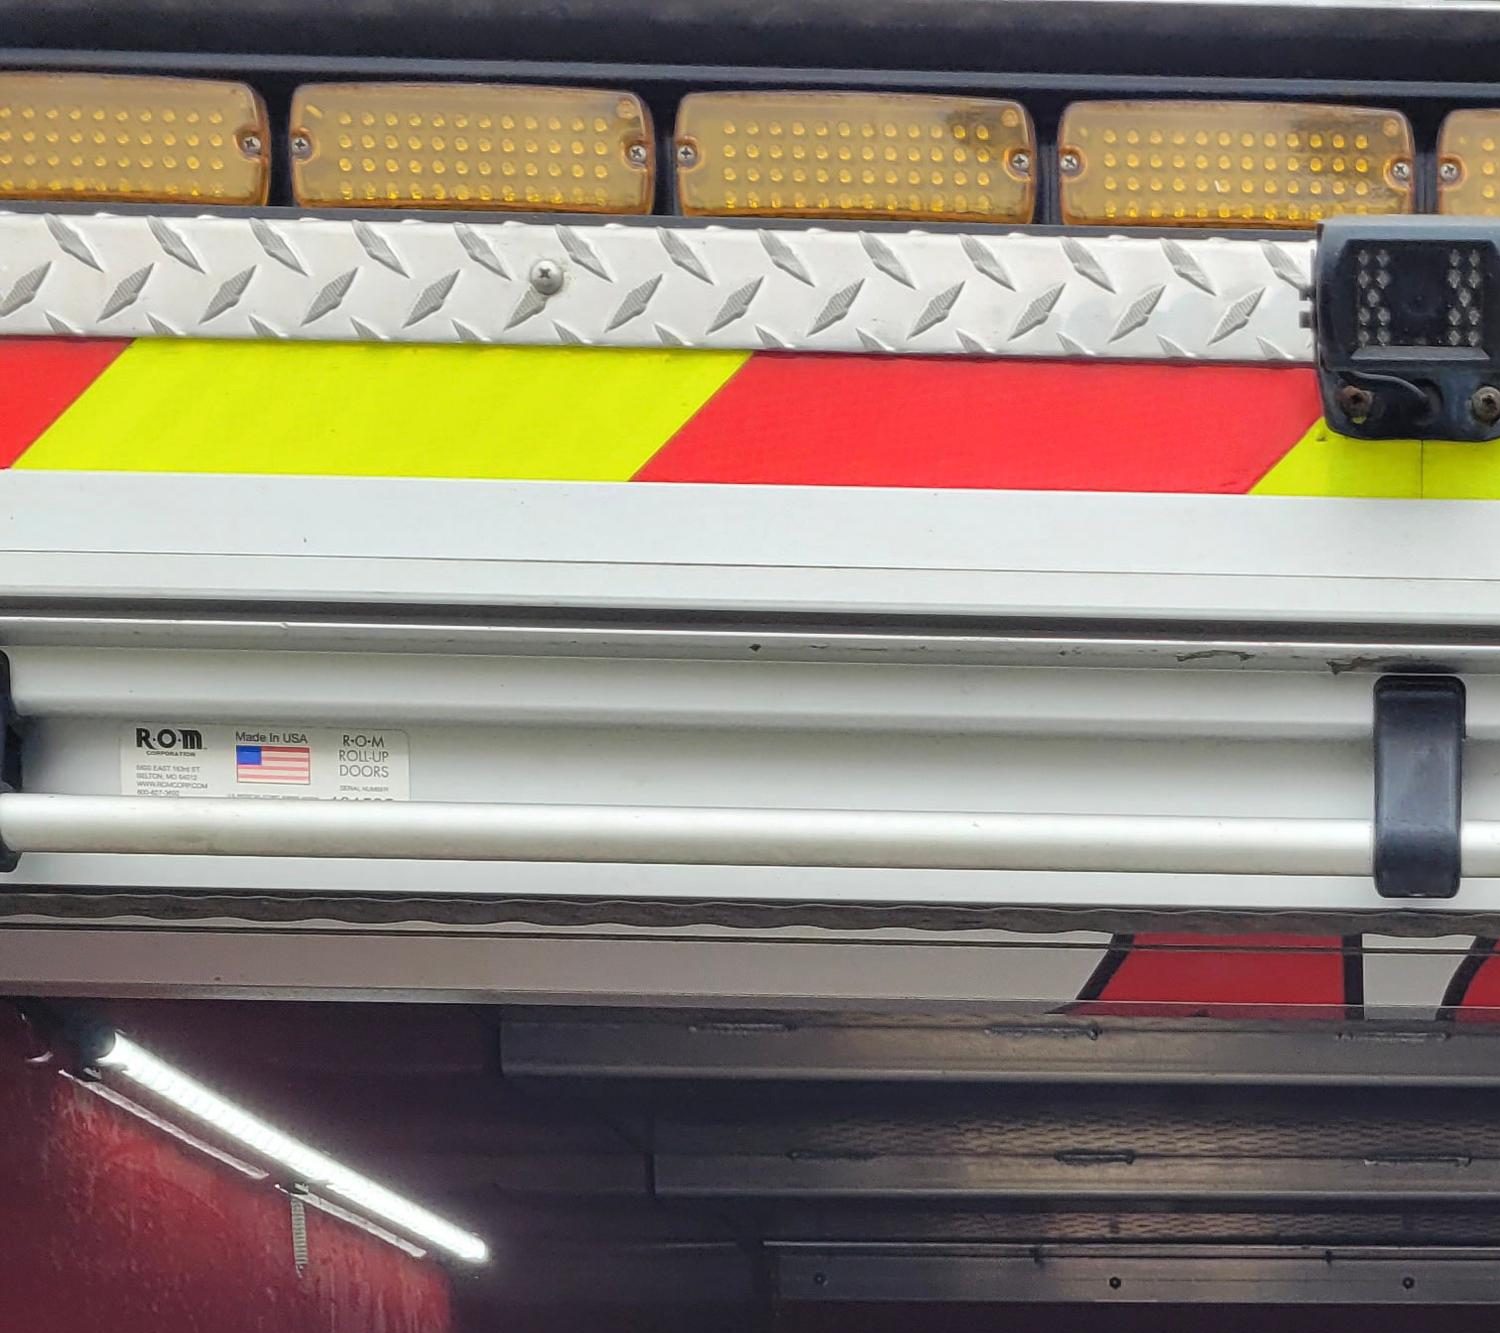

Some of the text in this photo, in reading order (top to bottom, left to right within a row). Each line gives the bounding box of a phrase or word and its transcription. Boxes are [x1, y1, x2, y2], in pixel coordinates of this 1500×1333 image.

[235, 731, 308, 744] Made In USA
[338, 749, 389, 763] ROLL-UP
[339, 765, 389, 778] DOORS
